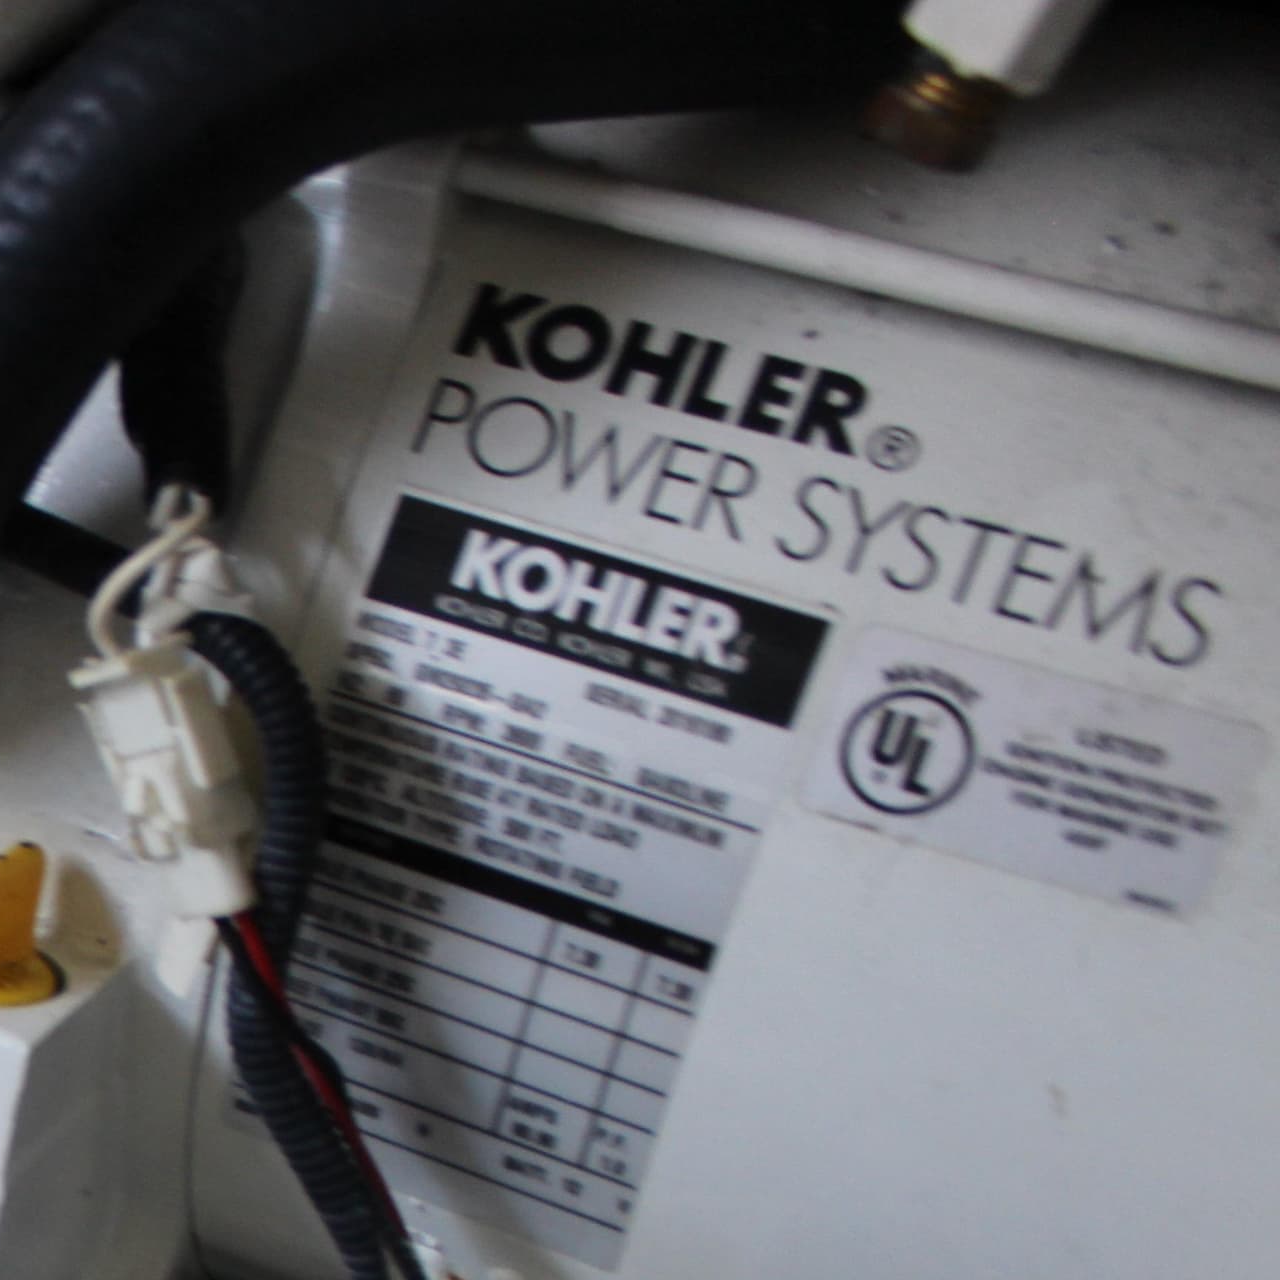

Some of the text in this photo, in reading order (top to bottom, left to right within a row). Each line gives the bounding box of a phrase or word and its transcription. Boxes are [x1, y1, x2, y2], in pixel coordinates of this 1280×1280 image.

[453, 283, 870, 457] KOHLER
[411, 377, 1227, 669] POWER SYSTEMS
[870, 707, 934, 797] UL
